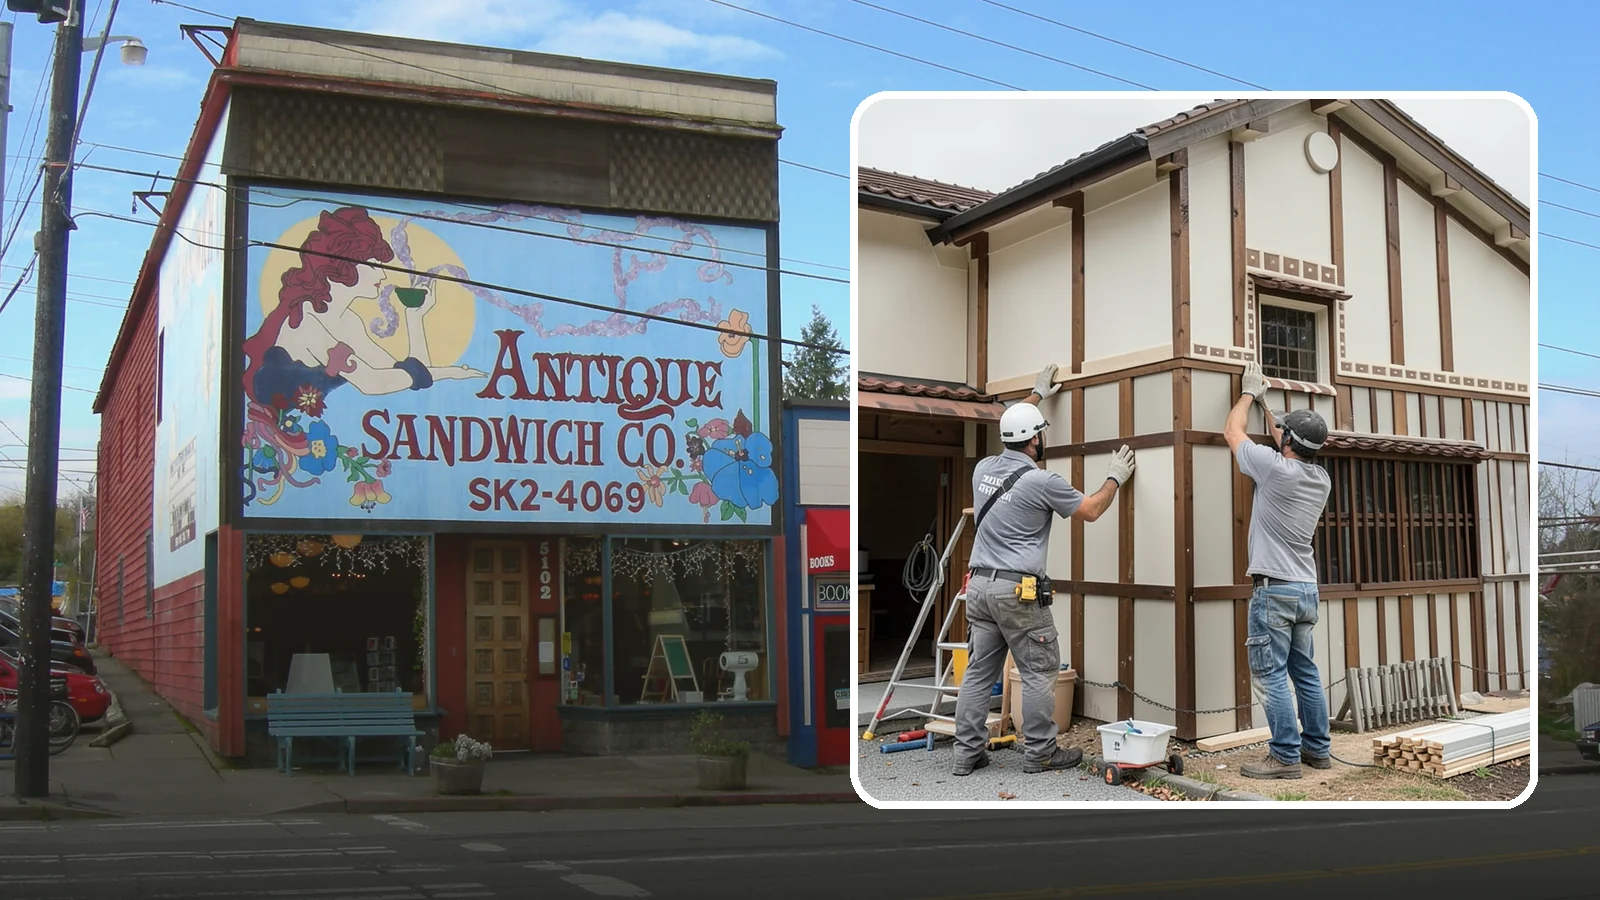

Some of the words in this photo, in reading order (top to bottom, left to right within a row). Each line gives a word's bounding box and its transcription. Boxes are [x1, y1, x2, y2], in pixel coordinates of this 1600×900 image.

[475, 328, 723, 421] ANTIQUE
[361, 408, 604, 467] SANDWICH
[617, 421, 685, 469] CO.
[467, 476, 646, 513] SK2-4069
[539, 541, 552, 600] 5102
[809, 555, 835, 569] BOOKS
